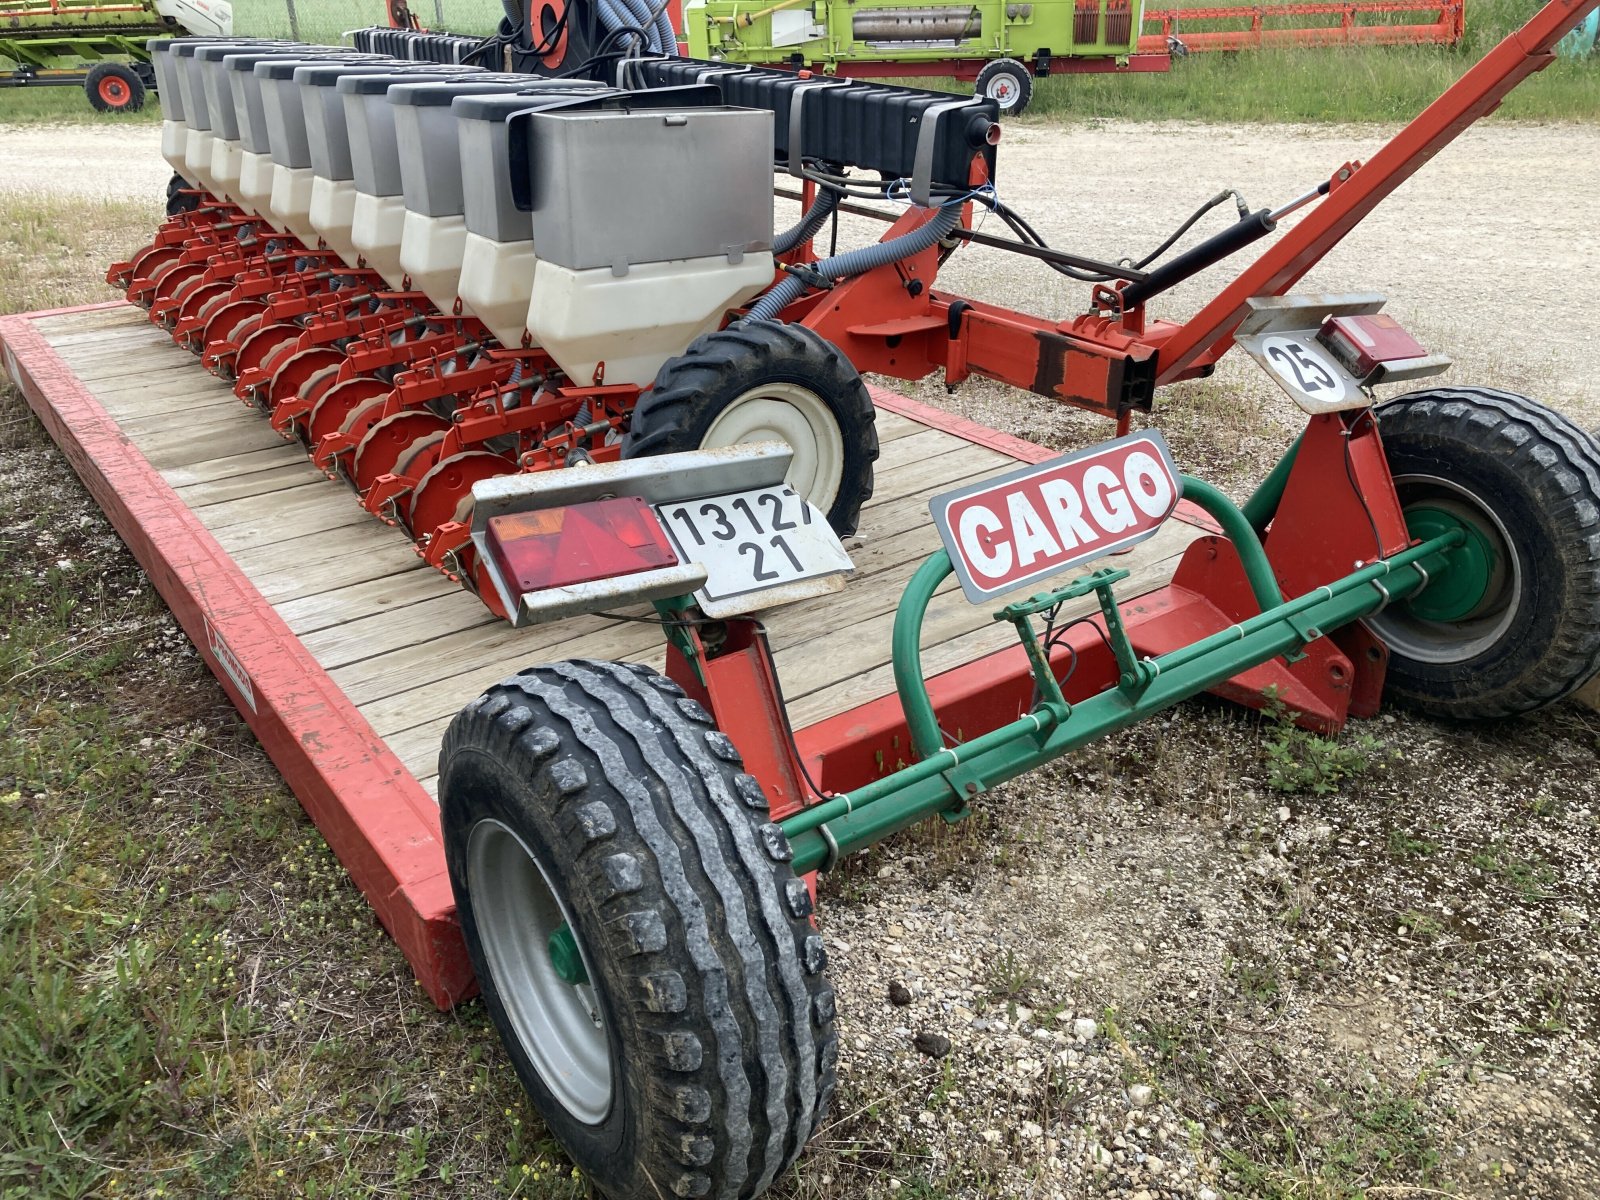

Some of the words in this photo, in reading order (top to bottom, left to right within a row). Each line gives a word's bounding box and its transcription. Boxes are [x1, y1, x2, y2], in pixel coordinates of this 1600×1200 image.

[1268, 344, 1335, 392] 25
[959, 451, 1172, 578] CARGO
[738, 535, 804, 582] 21
